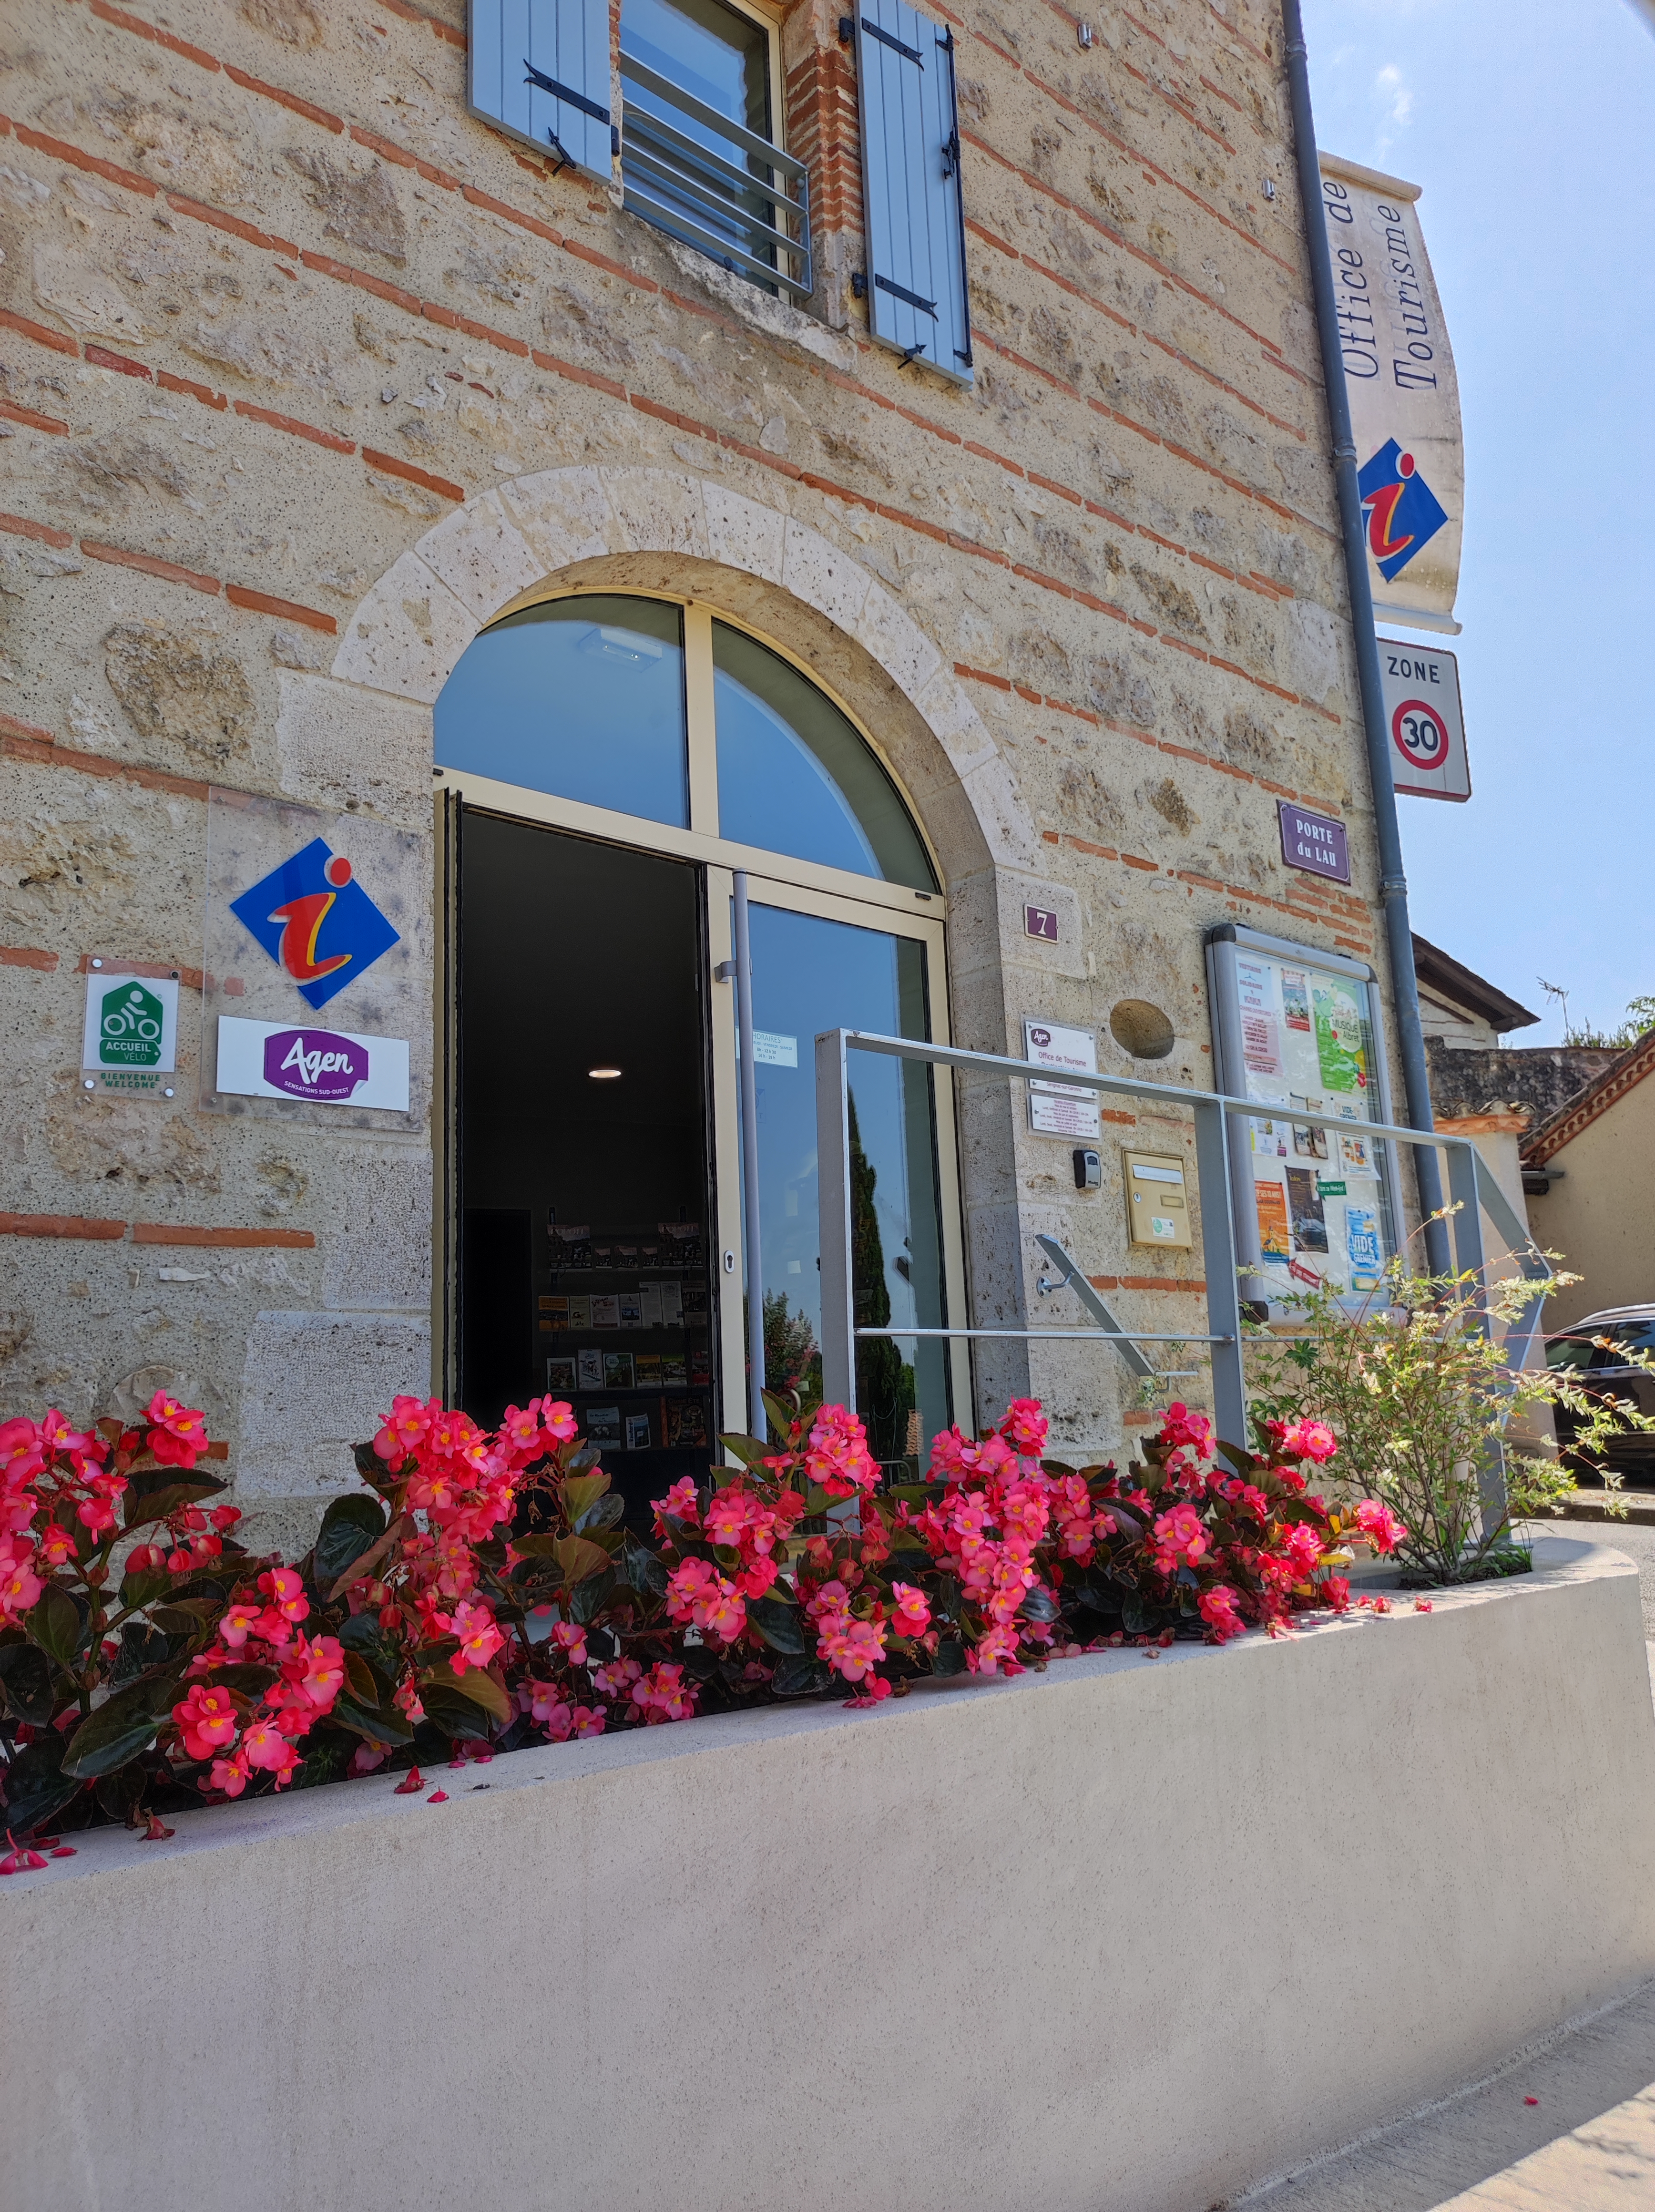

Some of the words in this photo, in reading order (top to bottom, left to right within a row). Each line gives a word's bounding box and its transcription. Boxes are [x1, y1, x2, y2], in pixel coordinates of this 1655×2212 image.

[1323, 181, 1353, 224] de
[1378, 205, 1437, 390] Tourisme
[1336, 247, 1379, 379] Office
[1387, 655, 1440, 684] ZONE
[1402, 717, 1438, 751] 30
[1296, 819, 1333, 845] PORTE
[1297, 841, 1312, 859] du
[1315, 847, 1337, 867] LAU
[1036, 911, 1047, 935] 7
[1332, 1018, 1358, 1034] MUSIQUE
[753, 1033, 781, 1044] HORAIRES
[1033, 1030, 1049, 1043] Agen
[1343, 1031, 1359, 1043] Albret
[105, 1041, 152, 1052] ACCUEIL
[123, 1051, 147, 1061] VÉLO
[280, 1036, 354, 1085] Agen
[1038, 1051, 1054, 1061] Office
[1063, 1056, 1086, 1067] Tourisme
[101, 1072, 161, 1081] BIENVENUE
[105, 1080, 156, 1088] WELCOME
[284, 1080, 318, 1095] SENSATIONS
[319, 1086, 350, 1095] SUD-OUEST
[1351, 1234, 1375, 1255] VIDE
[1354, 1253, 1375, 1264] GRENIER
